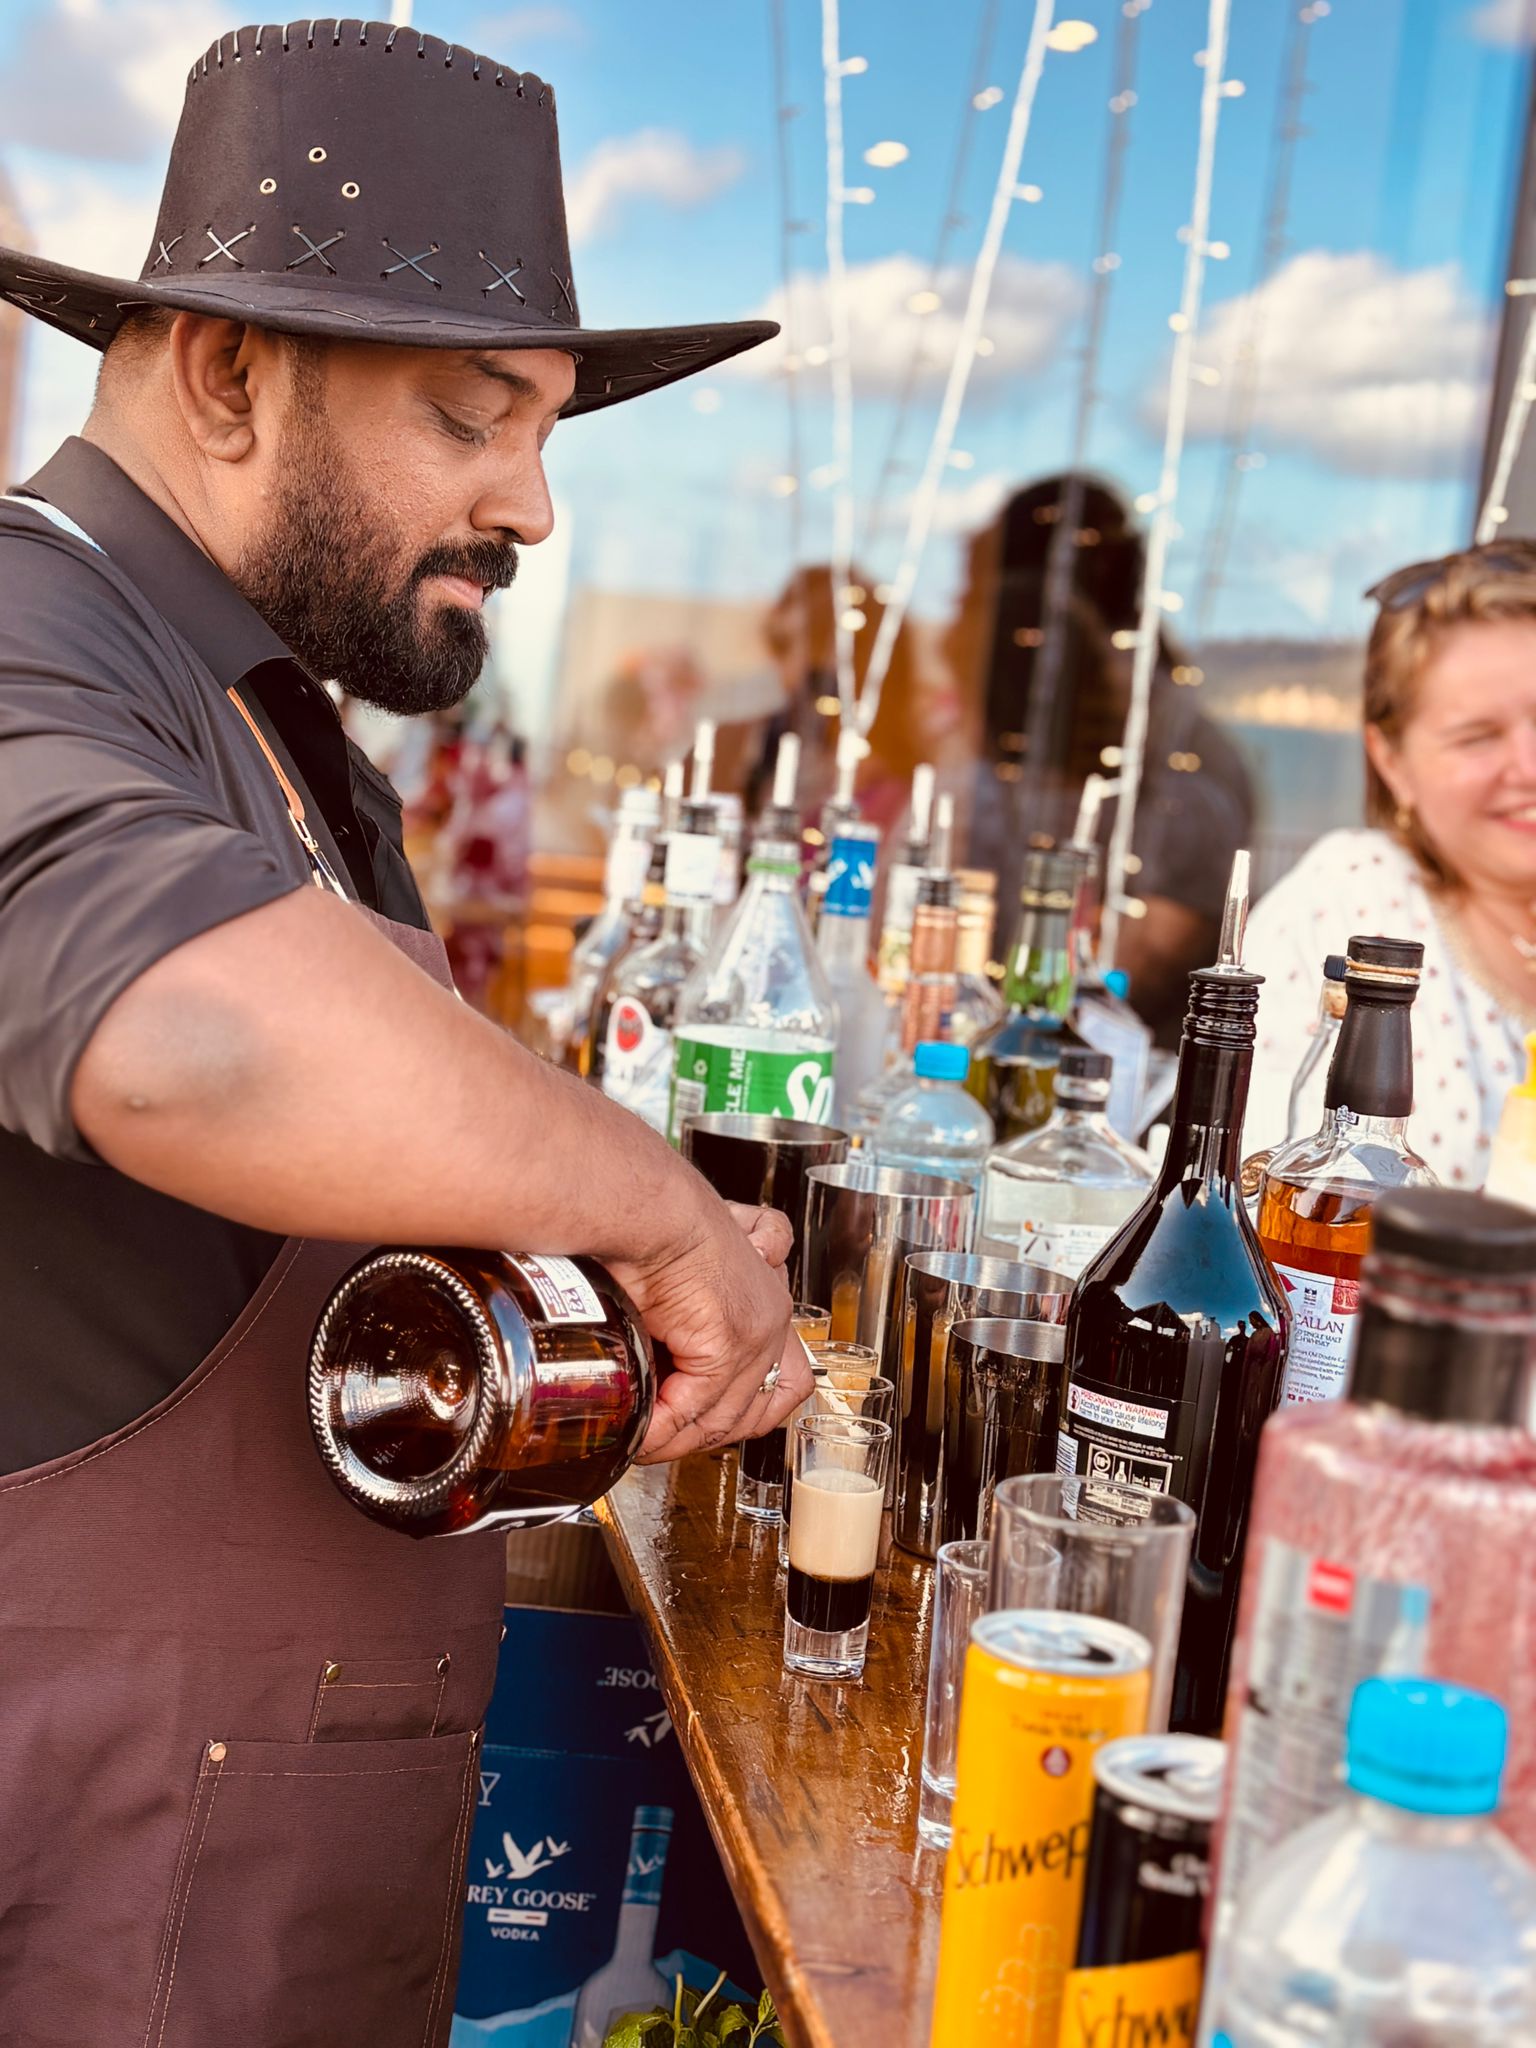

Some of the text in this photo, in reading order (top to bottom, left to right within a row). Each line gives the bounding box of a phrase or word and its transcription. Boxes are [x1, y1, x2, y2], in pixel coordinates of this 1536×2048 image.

[1295, 1313, 1344, 1334] CALLAN
[1101, 1406, 1114, 1415] can
[1114, 1411, 1137, 1422] cause
[1137, 1414, 1166, 1430] lifelong
[1124, 1403, 1167, 1420] WARNING
[1116, 1419, 1135, 1431] baby
[604, 1667, 659, 1690] OSE
[954, 1820, 1089, 1890] Schwep
[467, 1884, 590, 1912] REY GOOSE
[490, 1926, 540, 1941] VODKA
